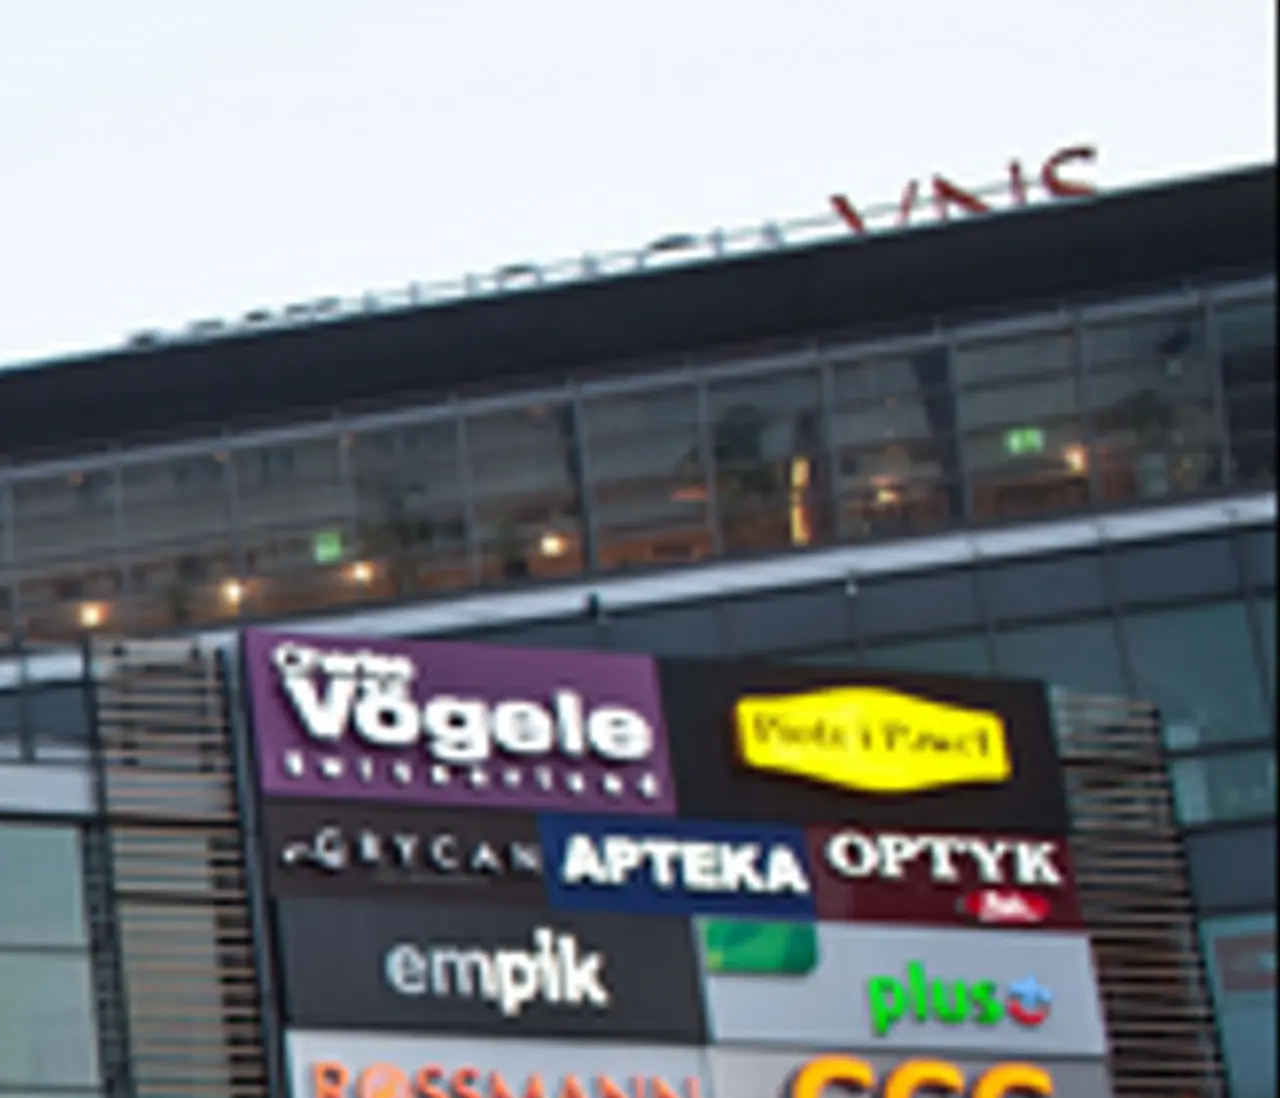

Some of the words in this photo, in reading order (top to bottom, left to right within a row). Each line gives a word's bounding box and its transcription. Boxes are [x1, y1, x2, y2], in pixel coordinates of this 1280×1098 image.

[560, 832, 811, 896] APTEKA
[825, 831, 1066, 887] OPTYK
[384, 926, 611, 1018] empik
[867, 958, 1006, 1038] plus
